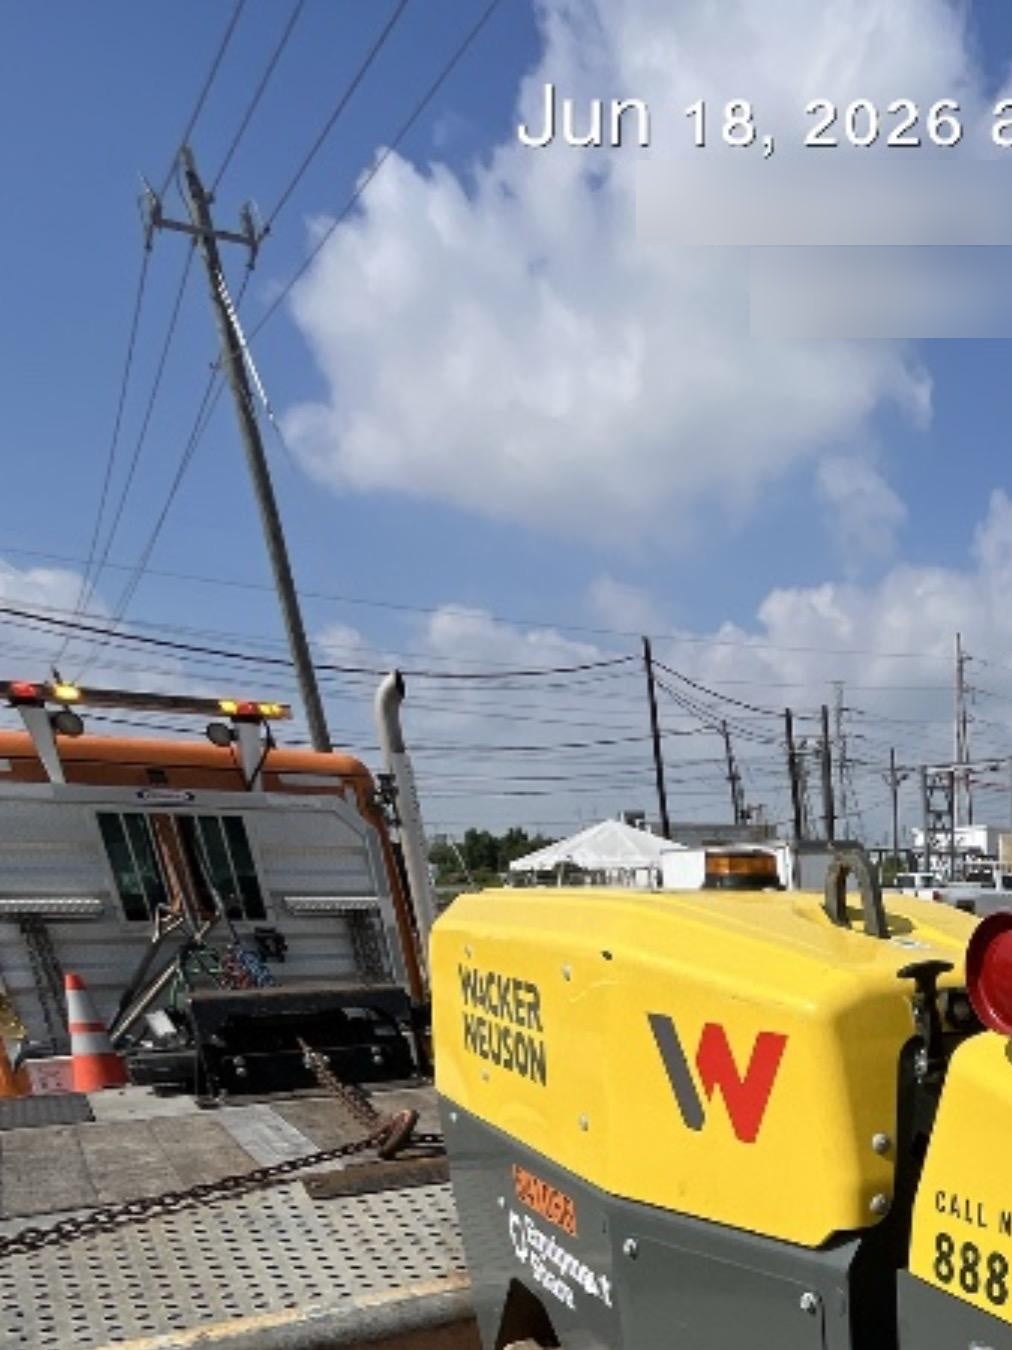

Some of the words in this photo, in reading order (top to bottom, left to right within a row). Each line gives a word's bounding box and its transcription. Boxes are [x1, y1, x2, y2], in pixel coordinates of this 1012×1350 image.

[458, 963, 543, 1032] WACKER
[463, 1012, 546, 1086] NEUSON
[935, 1190, 988, 1228] CALL
